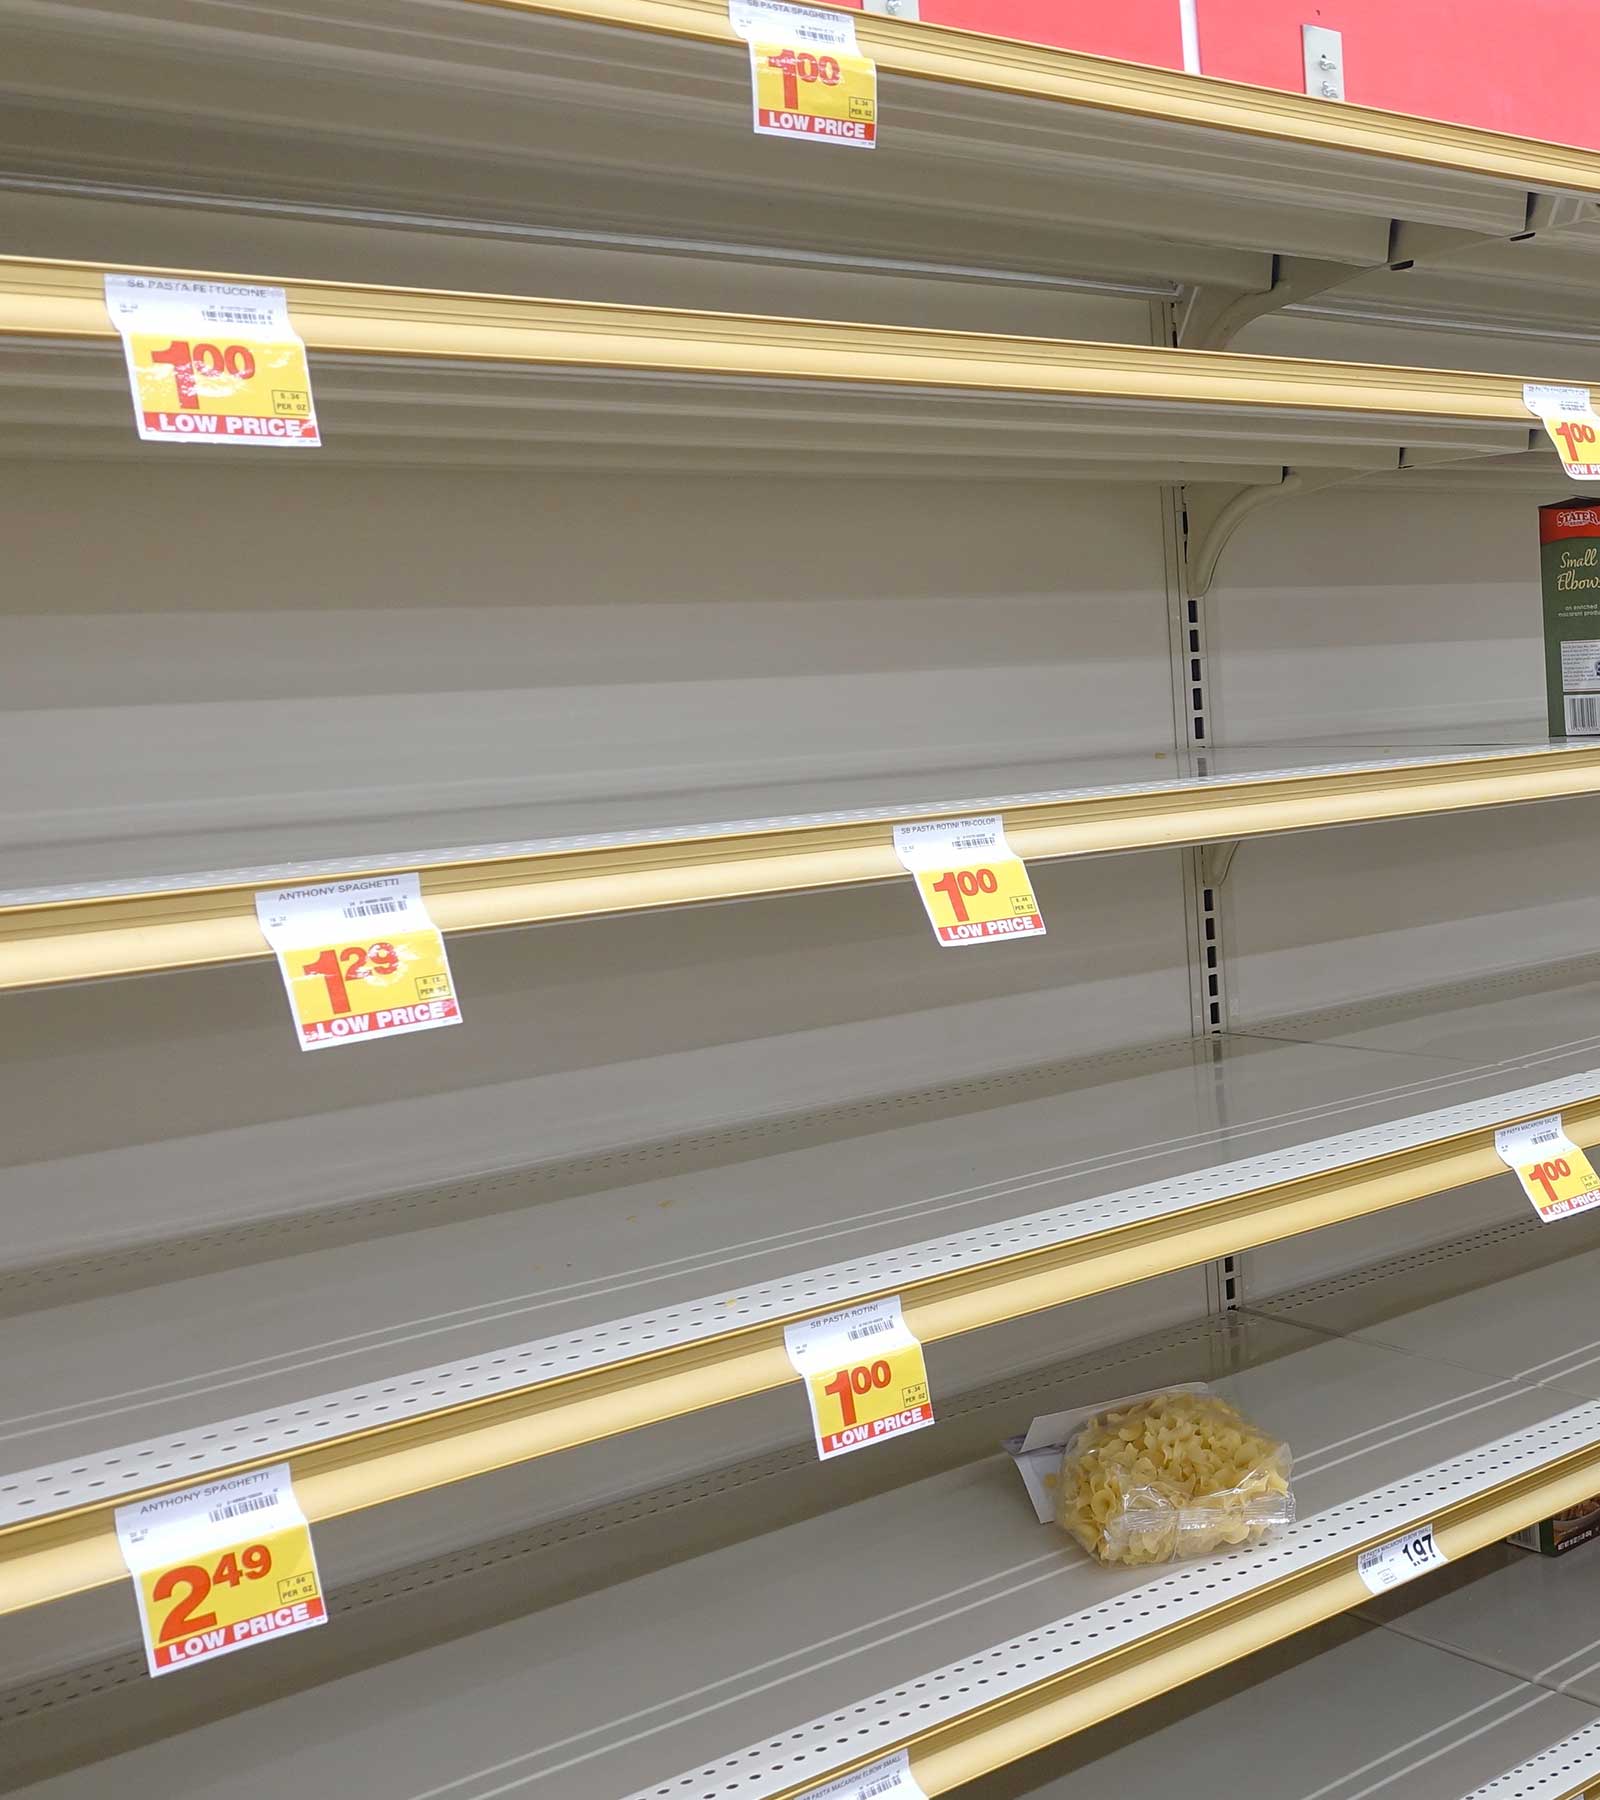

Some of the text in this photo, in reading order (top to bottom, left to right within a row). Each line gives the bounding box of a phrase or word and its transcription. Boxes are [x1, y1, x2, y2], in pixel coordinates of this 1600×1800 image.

[792, 8, 839, 22] SPAGHETTI
[769, 112, 866, 138] LOW PRICE
[276, 402, 293, 411] PER
[159, 413, 303, 437] LOW PRICE
[1567, 464, 1588, 474] LOW
[1560, 548, 1598, 569] Small
[912, 824, 935, 833] PASTA
[278, 877, 400, 902] ANTHONY SPAGHETTI
[947, 916, 1035, 940] LOW PRICE
[316, 1000, 446, 1039] LOW PRICE
[1545, 1200, 1570, 1216] LOW
[823, 1312, 850, 1326] PASTA
[831, 1407, 924, 1449] LOW PRICE
[140, 1471, 270, 1515] ANTHONY SPAGHETTI
[153, 1544, 272, 1643] 249
[169, 1603, 310, 1662] LOW PRICE
